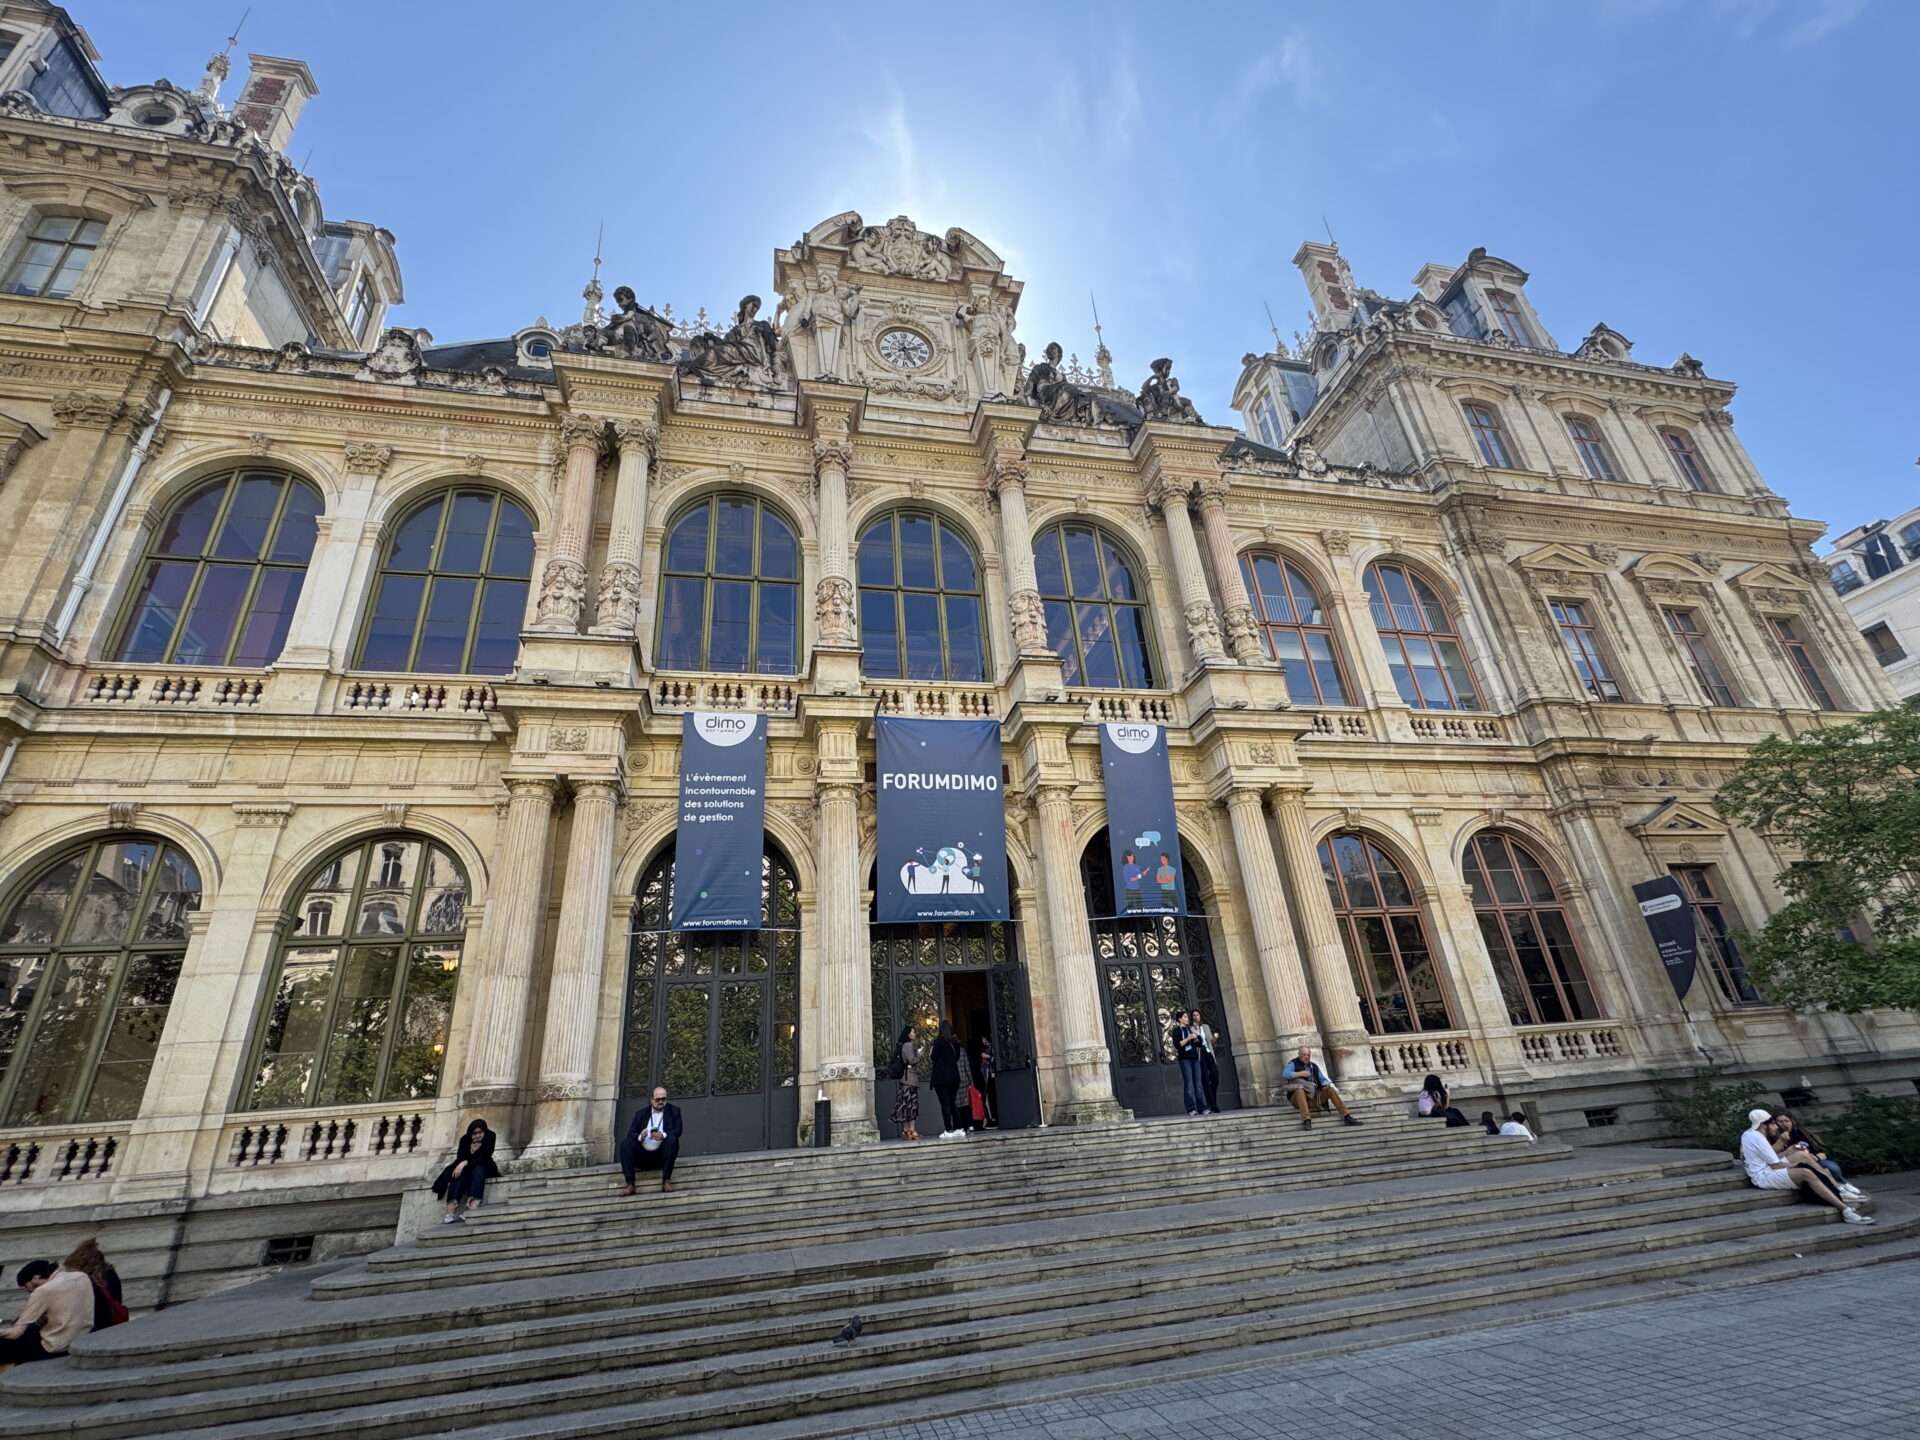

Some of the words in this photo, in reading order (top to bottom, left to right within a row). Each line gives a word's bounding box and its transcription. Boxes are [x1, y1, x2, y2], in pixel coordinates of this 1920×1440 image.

[706, 716, 746, 729] dimo
[1117, 726, 1150, 739] dimo
[686, 773, 747, 782] L'évènement
[882, 773, 998, 791] FORUMDIMO
[685, 786, 756, 795] incontournable
[684, 800, 702, 809] des
[703, 800, 745, 809] solutions
[683, 813, 697, 822] de
[699, 812, 734, 824] gestion
[682, 918, 748, 927] www.forumdimo.fr
